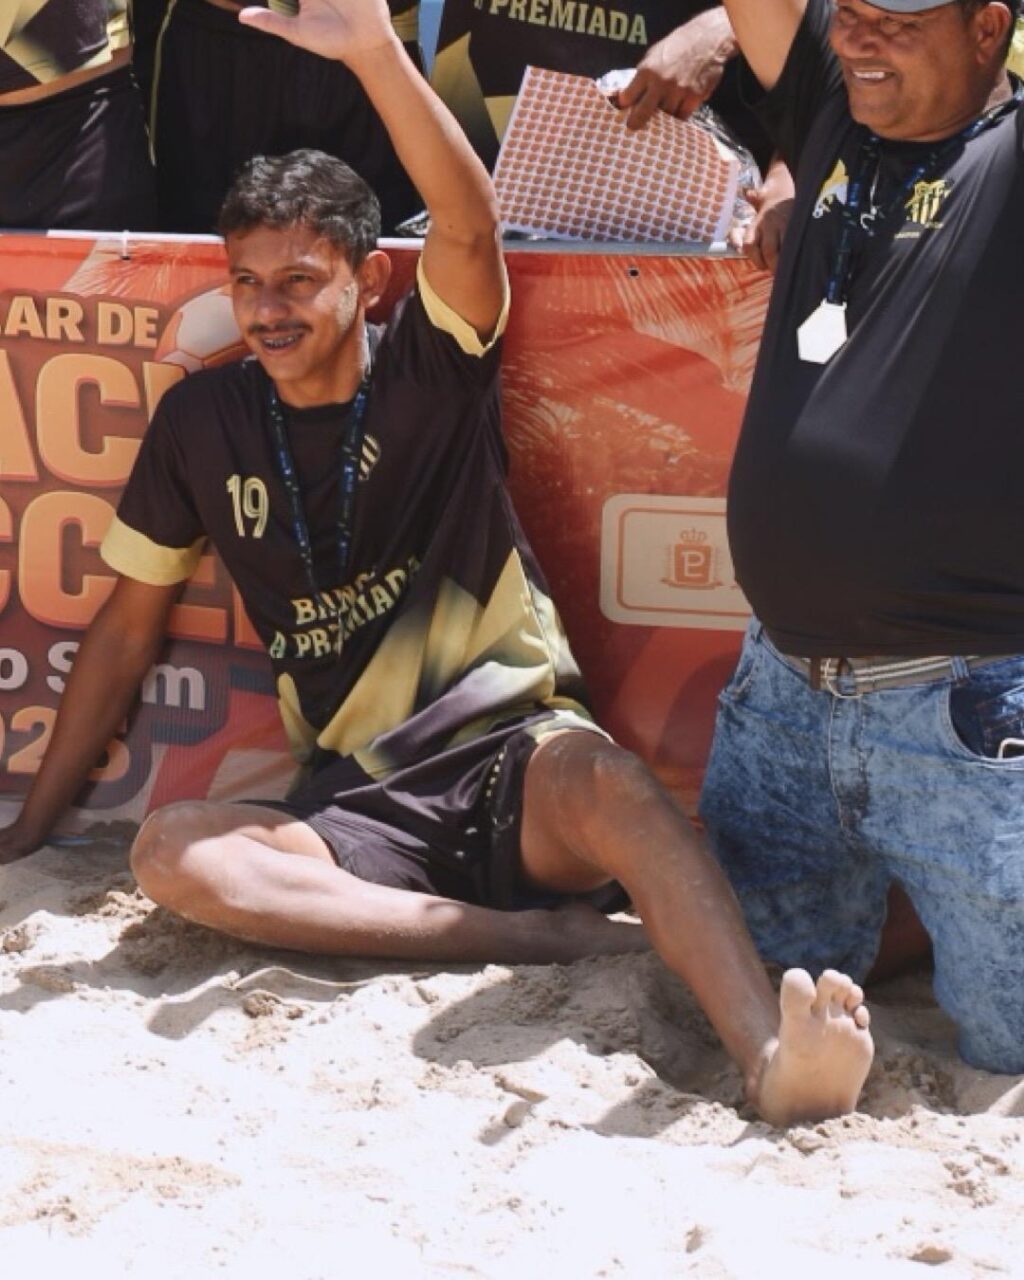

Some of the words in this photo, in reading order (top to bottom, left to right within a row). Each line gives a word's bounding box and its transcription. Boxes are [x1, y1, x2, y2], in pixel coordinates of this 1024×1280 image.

[97, 303, 159, 347] DE
[227, 474, 269, 539] 19
[46, 641, 205, 710] Sm
